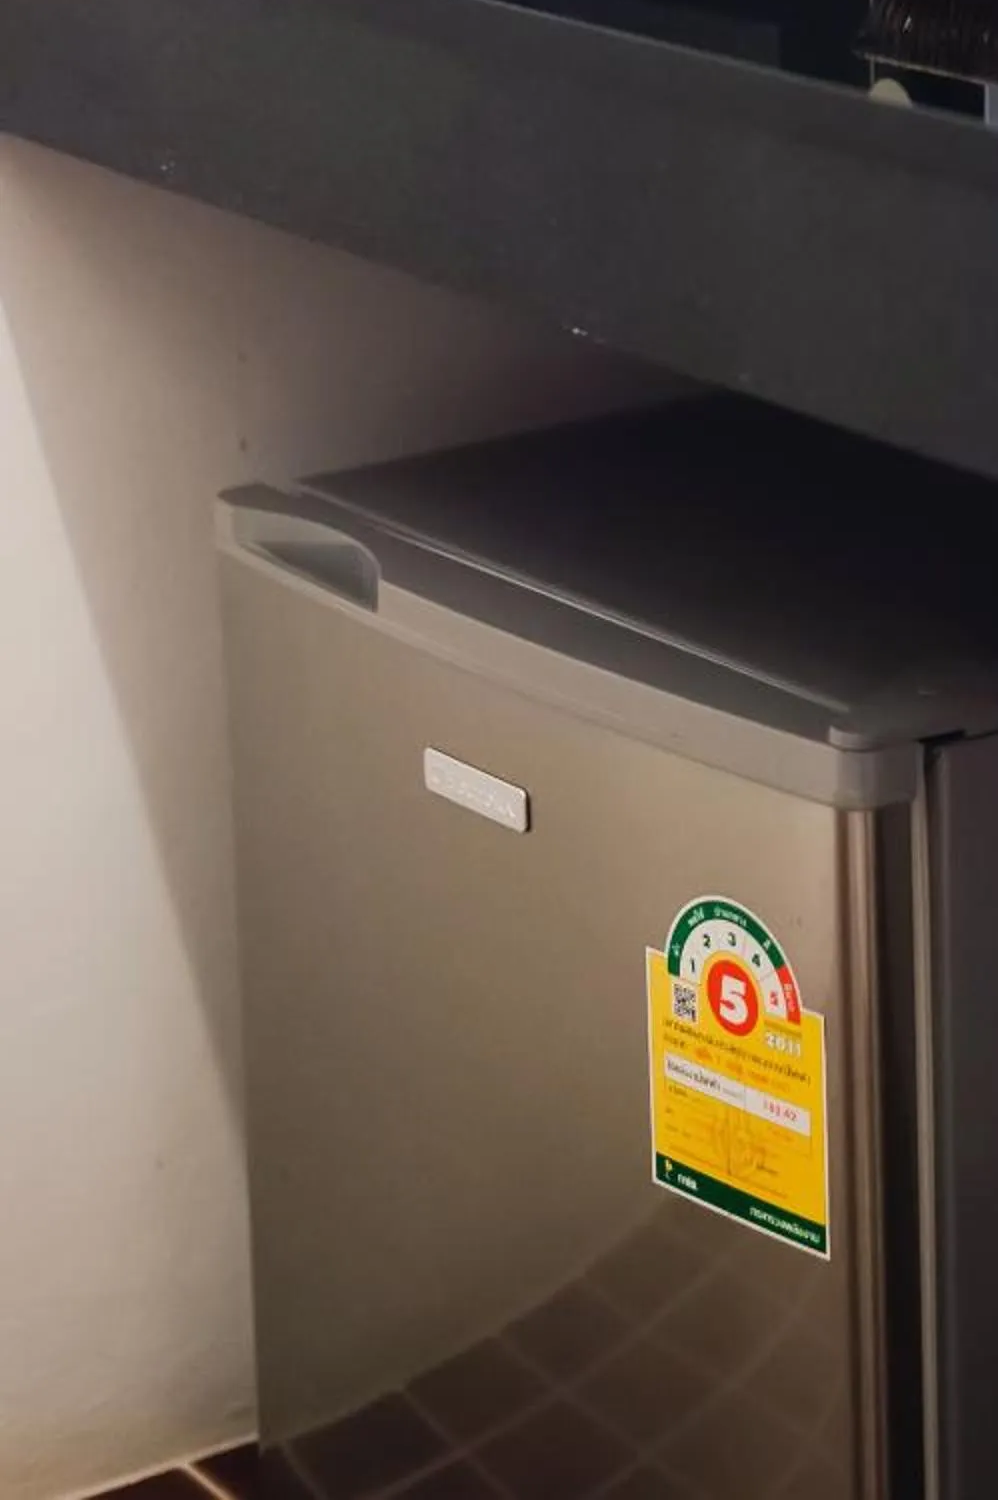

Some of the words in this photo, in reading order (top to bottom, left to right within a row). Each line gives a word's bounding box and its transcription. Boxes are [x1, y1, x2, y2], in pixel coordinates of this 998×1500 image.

[689, 956, 697, 973] 1
[702, 932, 711, 949] 2
[727, 931, 737, 947] 3
[719, 973, 749, 1027] 5
